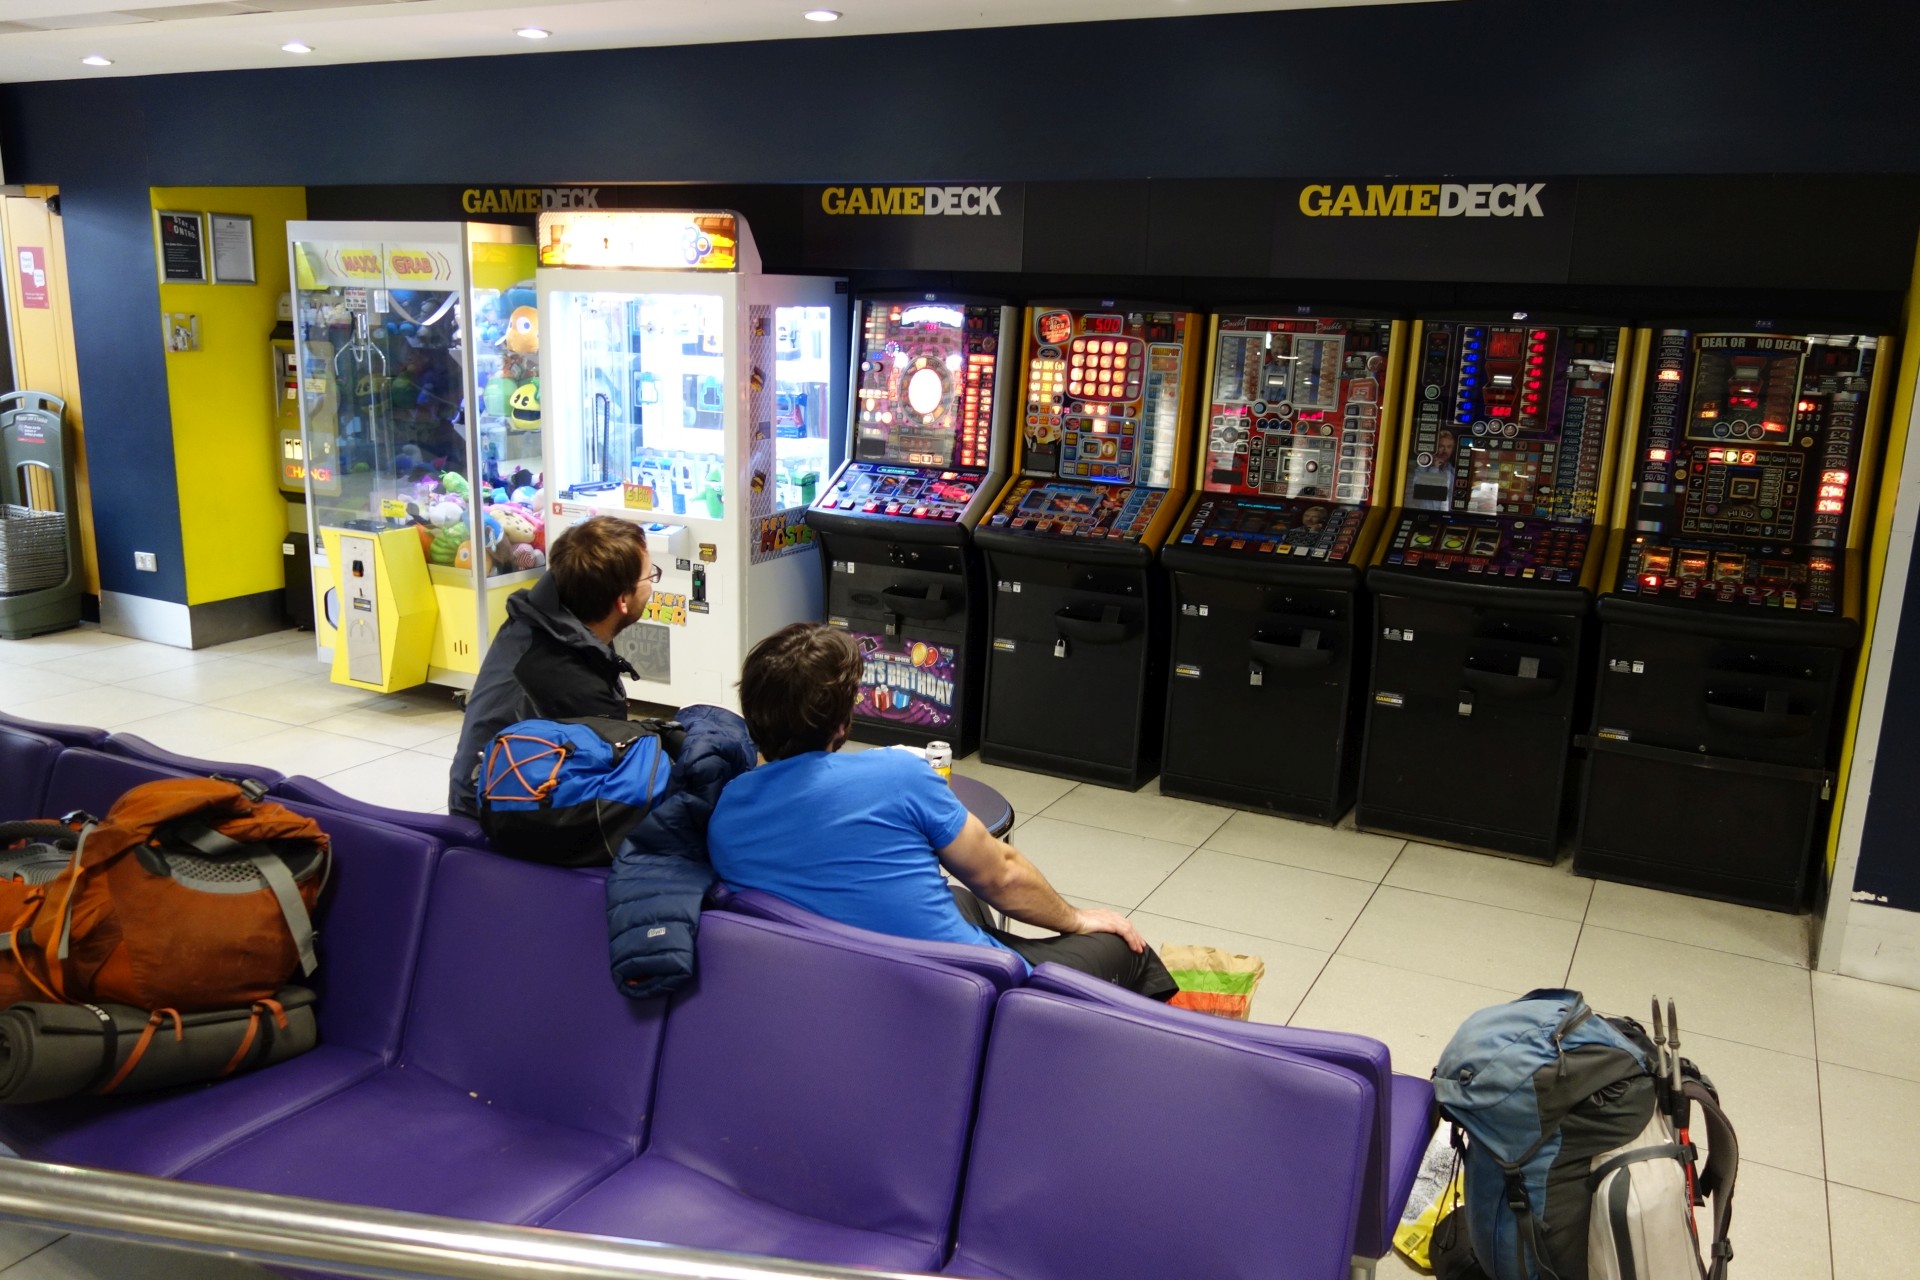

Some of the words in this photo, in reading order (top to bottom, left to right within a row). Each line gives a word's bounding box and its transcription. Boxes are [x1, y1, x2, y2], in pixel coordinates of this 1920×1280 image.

[462, 187, 600, 213] GAMEDECK
[821, 186, 1002, 215] GAMEDECK
[1299, 183, 1545, 217] GAMEDECK
[342, 255, 382, 274] MAXX
[391, 255, 433, 275] GRAB
[1221, 319, 1247, 328] Double
[1315, 322, 1342, 331] Double
[1701, 337, 1729, 348] DEAL
[1730, 337, 1746, 348] OR
[1756, 338, 1773, 349] NO
[1775, 339, 1802, 351] DEAL
[1831, 416, 1853, 426] £5
[1829, 430, 1850, 440] £4
[1827, 444, 1849, 454] £3
[1644, 473, 1666, 481] 50/50
[1737, 484, 1750, 494] 2
[1727, 510, 1738, 518] HI
[1741, 510, 1754, 519] LO
[1815, 530, 1836, 540] £1
[1664, 579, 1678, 588] 2
[1684, 581, 1697, 590] 3
[1722, 584, 1736, 593] 5
[1742, 586, 1757, 595] 6
[1761, 588, 1776, 597] 7
[653, 591, 687, 608] KEY
[641, 602, 688, 625] STER
[861, 660, 887, 685] ER'S
[887, 662, 954, 706] BIRTHDAY
